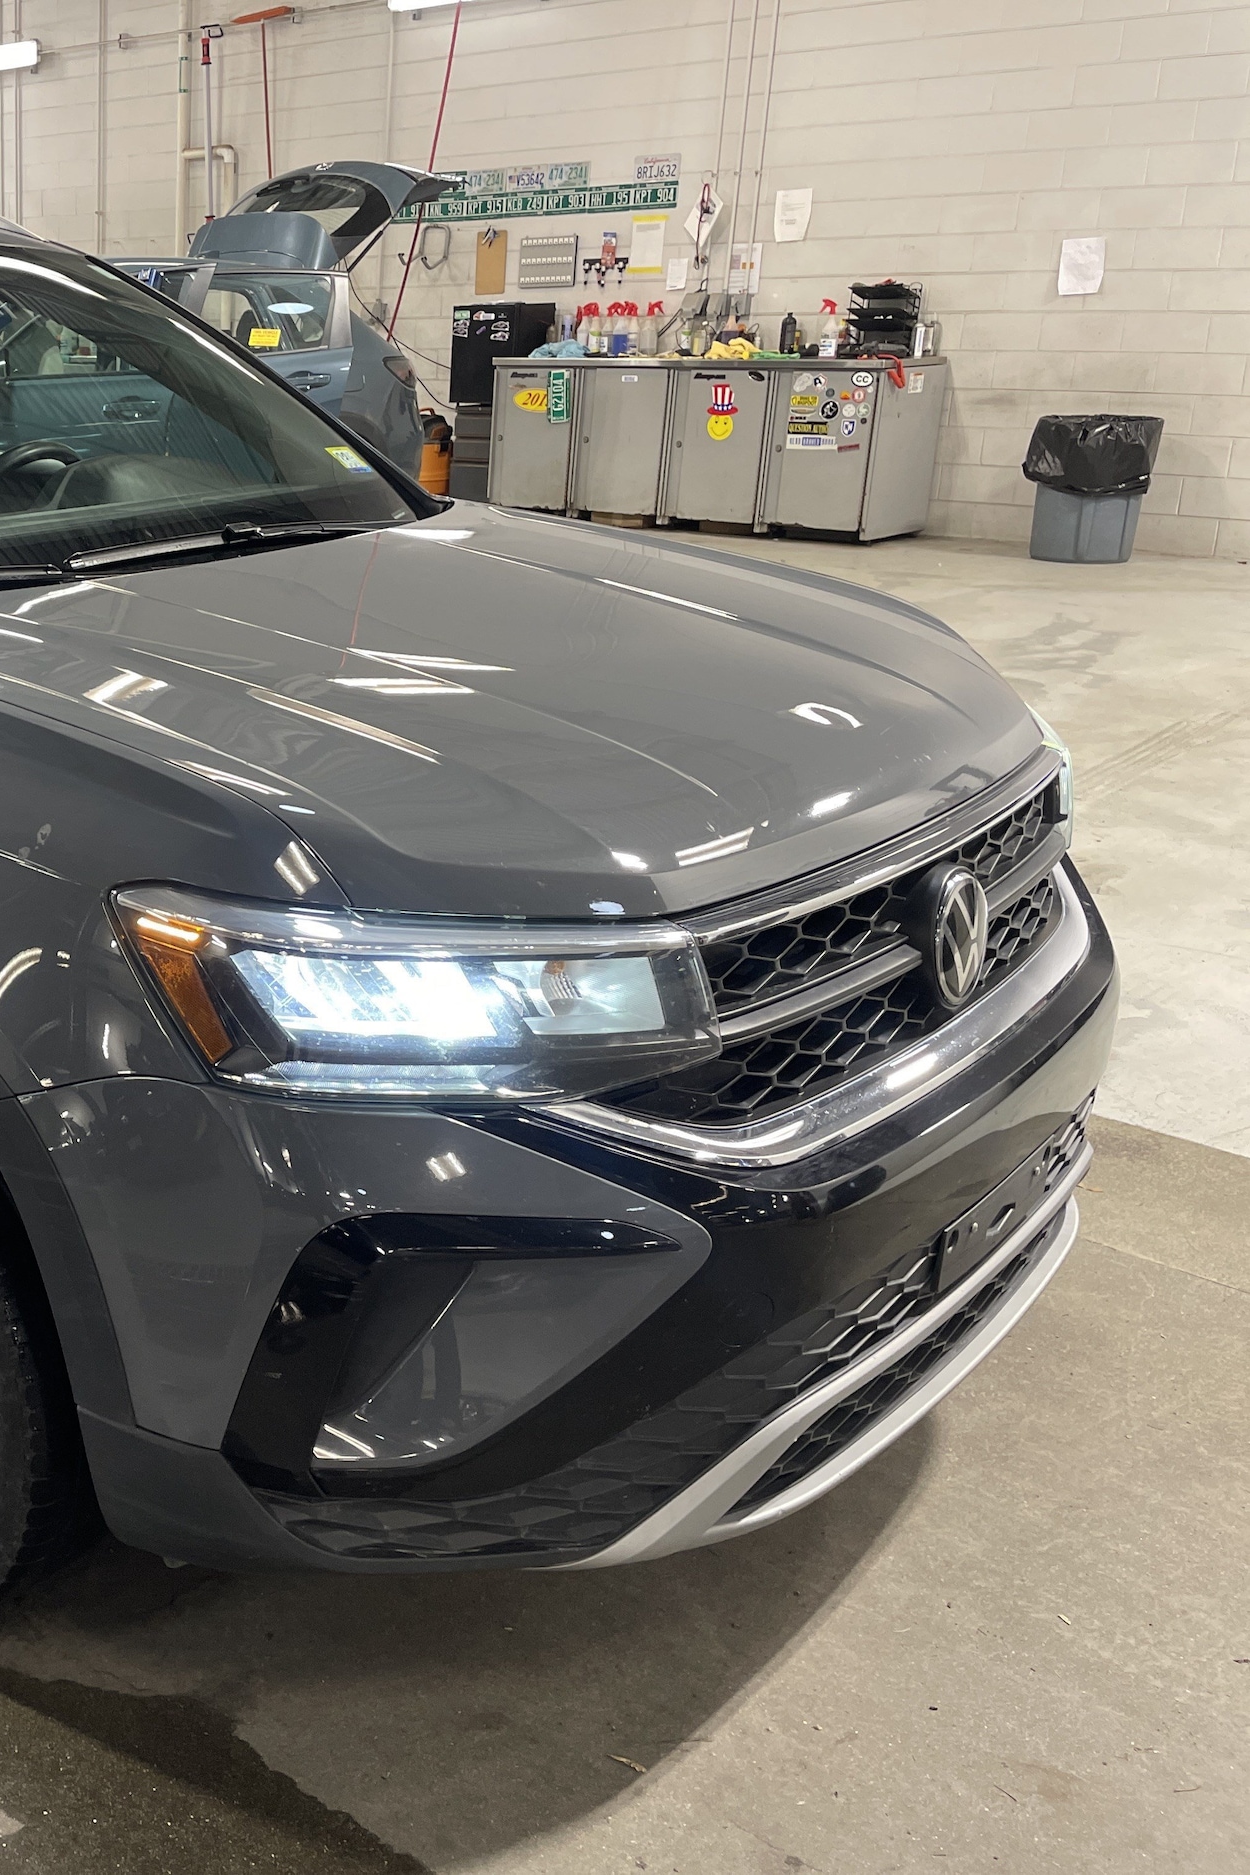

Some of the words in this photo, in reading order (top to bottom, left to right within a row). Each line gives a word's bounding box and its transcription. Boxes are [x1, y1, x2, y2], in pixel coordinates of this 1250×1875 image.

[568, 165, 587, 180] 2341
[637, 164, 677, 180] 8RIJ632
[526, 196, 543, 210] 249
[548, 195, 564, 209] KPT
[568, 194, 584, 208] 903
[591, 192, 607, 206] HHT
[611, 191, 628, 205] 195
[635, 189, 652, 204] KPT
[657, 187, 675, 202] 904
[447, 202, 463, 216] 959
[468, 201, 483, 215] KPT
[487, 200, 502, 214] 915
[855, 374, 870, 384] CC
[522, 391, 548, 407] 201
